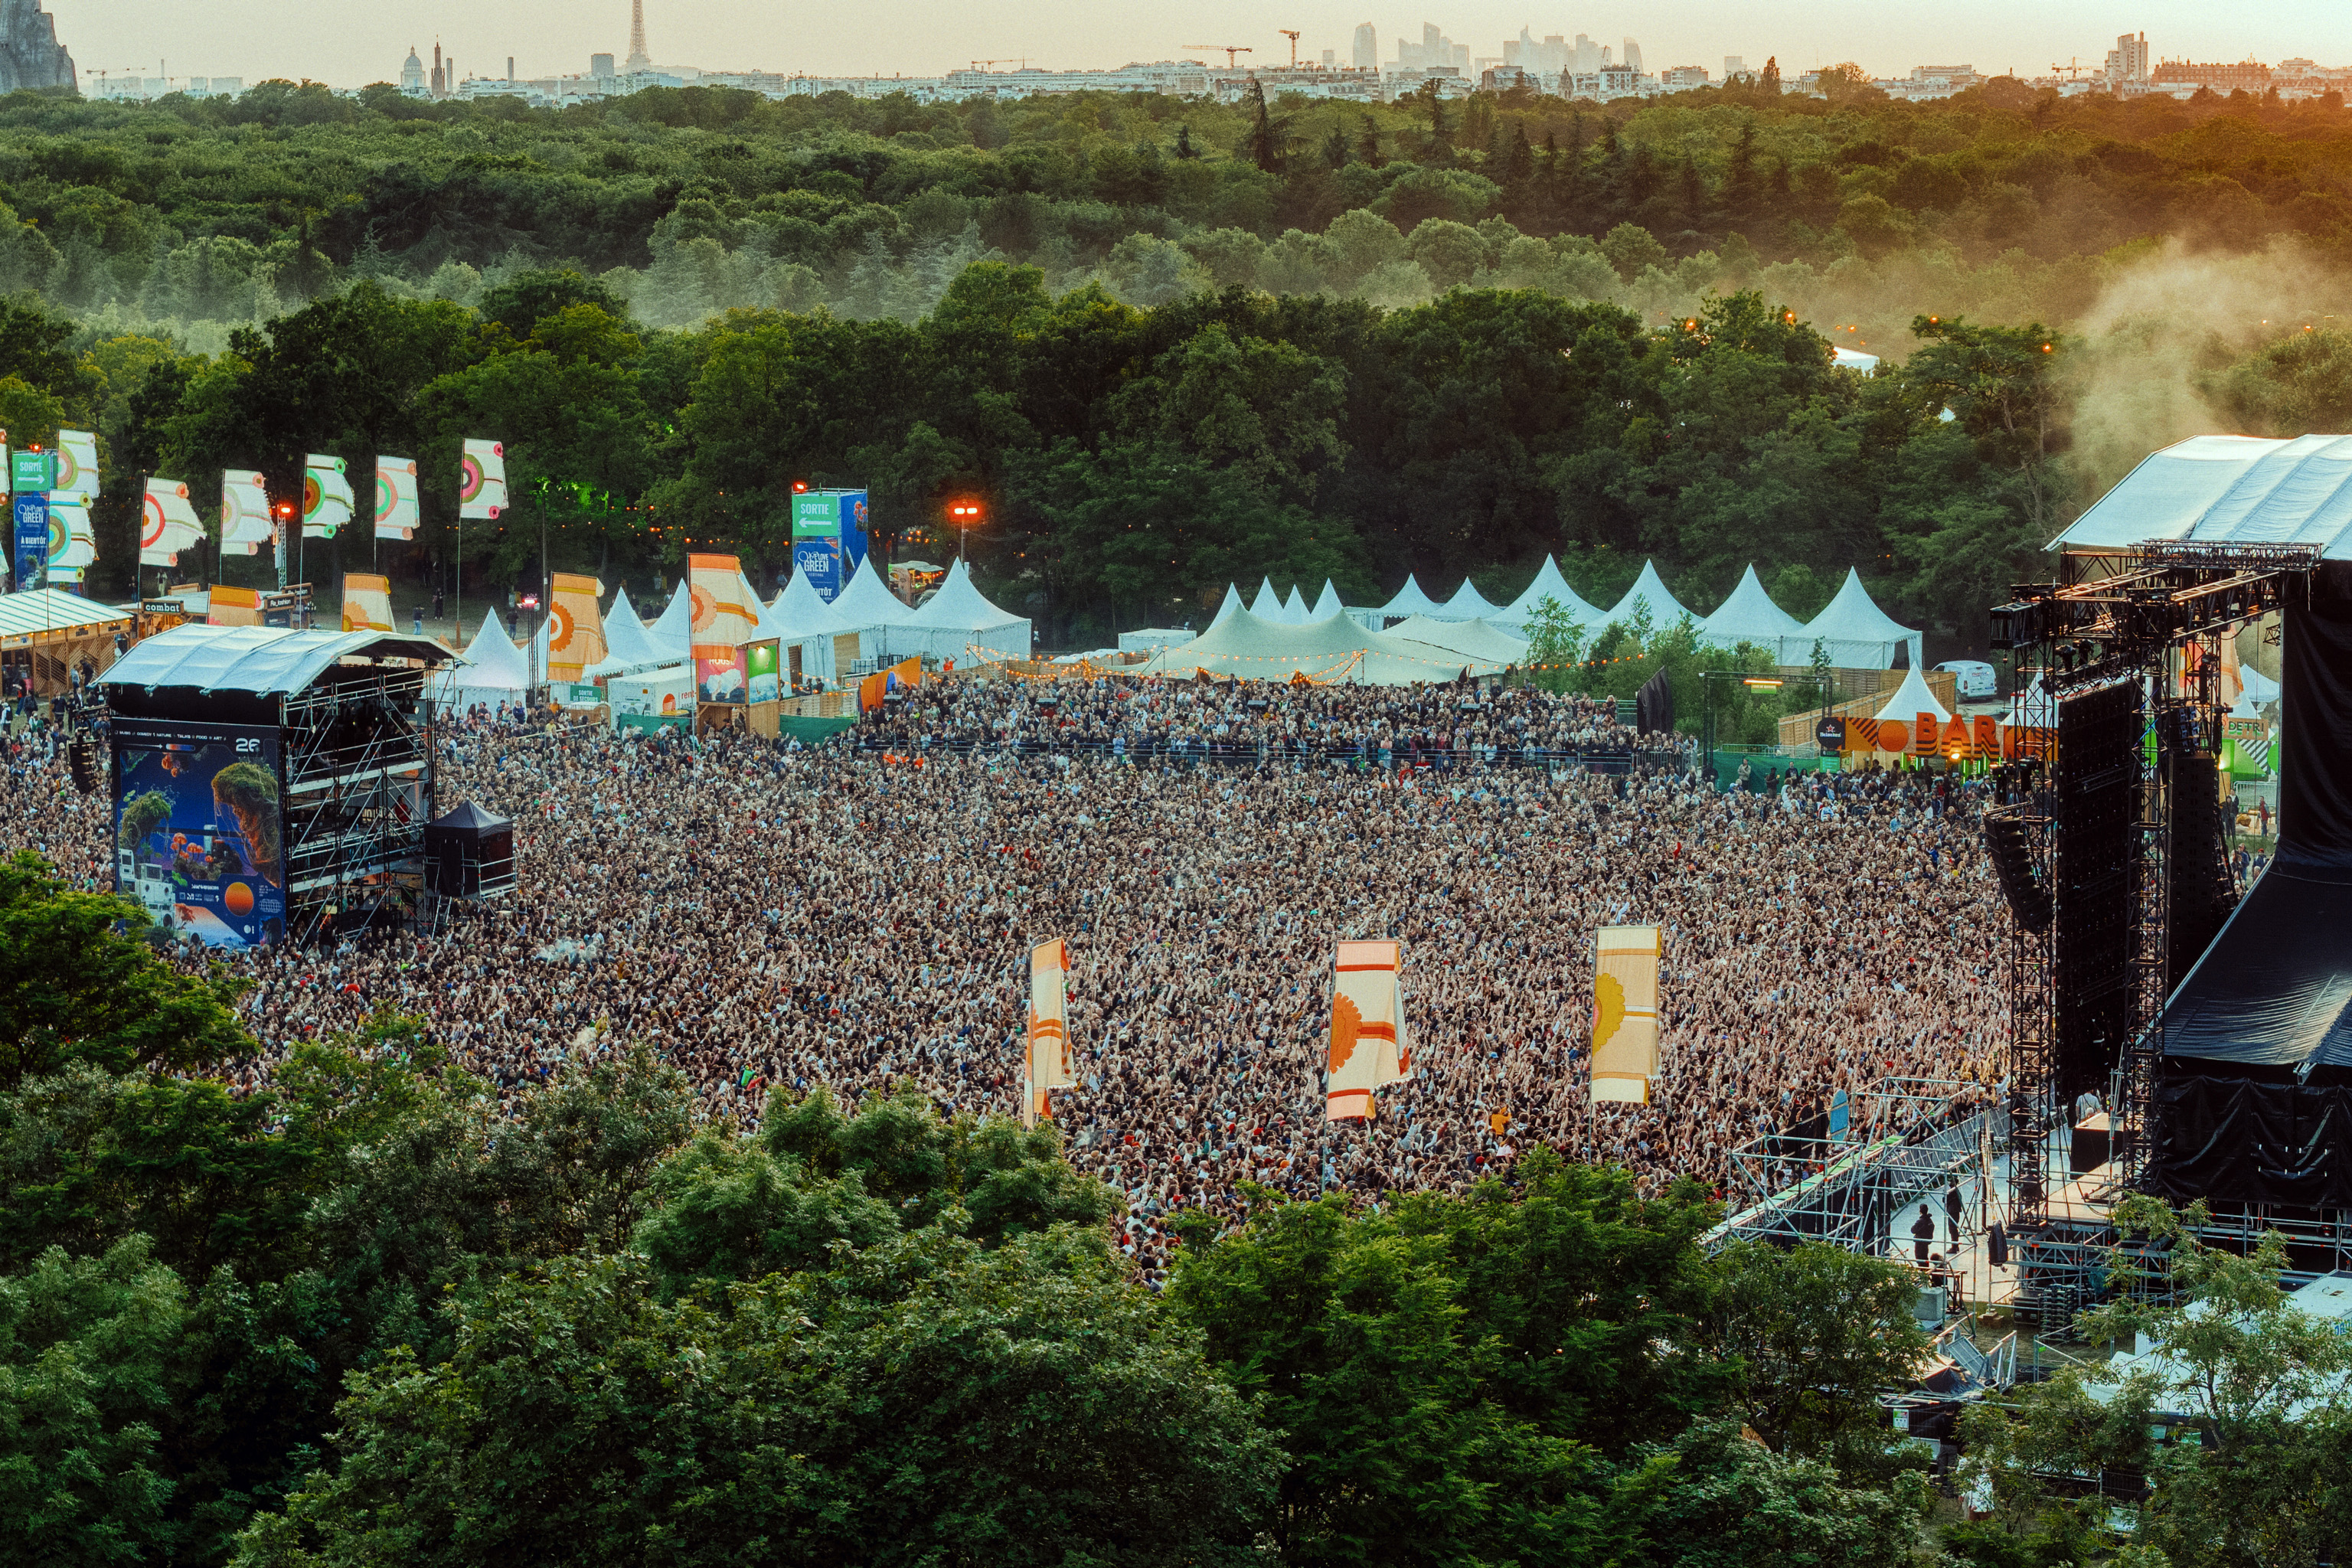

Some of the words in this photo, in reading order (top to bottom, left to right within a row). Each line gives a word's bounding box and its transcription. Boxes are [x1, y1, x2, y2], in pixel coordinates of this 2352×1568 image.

[20, 462, 42, 472] SORTIE
[801, 504, 829, 514] SORTIE
[23, 512, 44, 523] GREEN
[25, 536, 47, 544] BIENTÔT
[804, 560, 828, 572] GREEN
[145, 603, 179, 612] combat
[1916, 712, 2000, 761] BAR
[236, 738, 260, 752] 26
